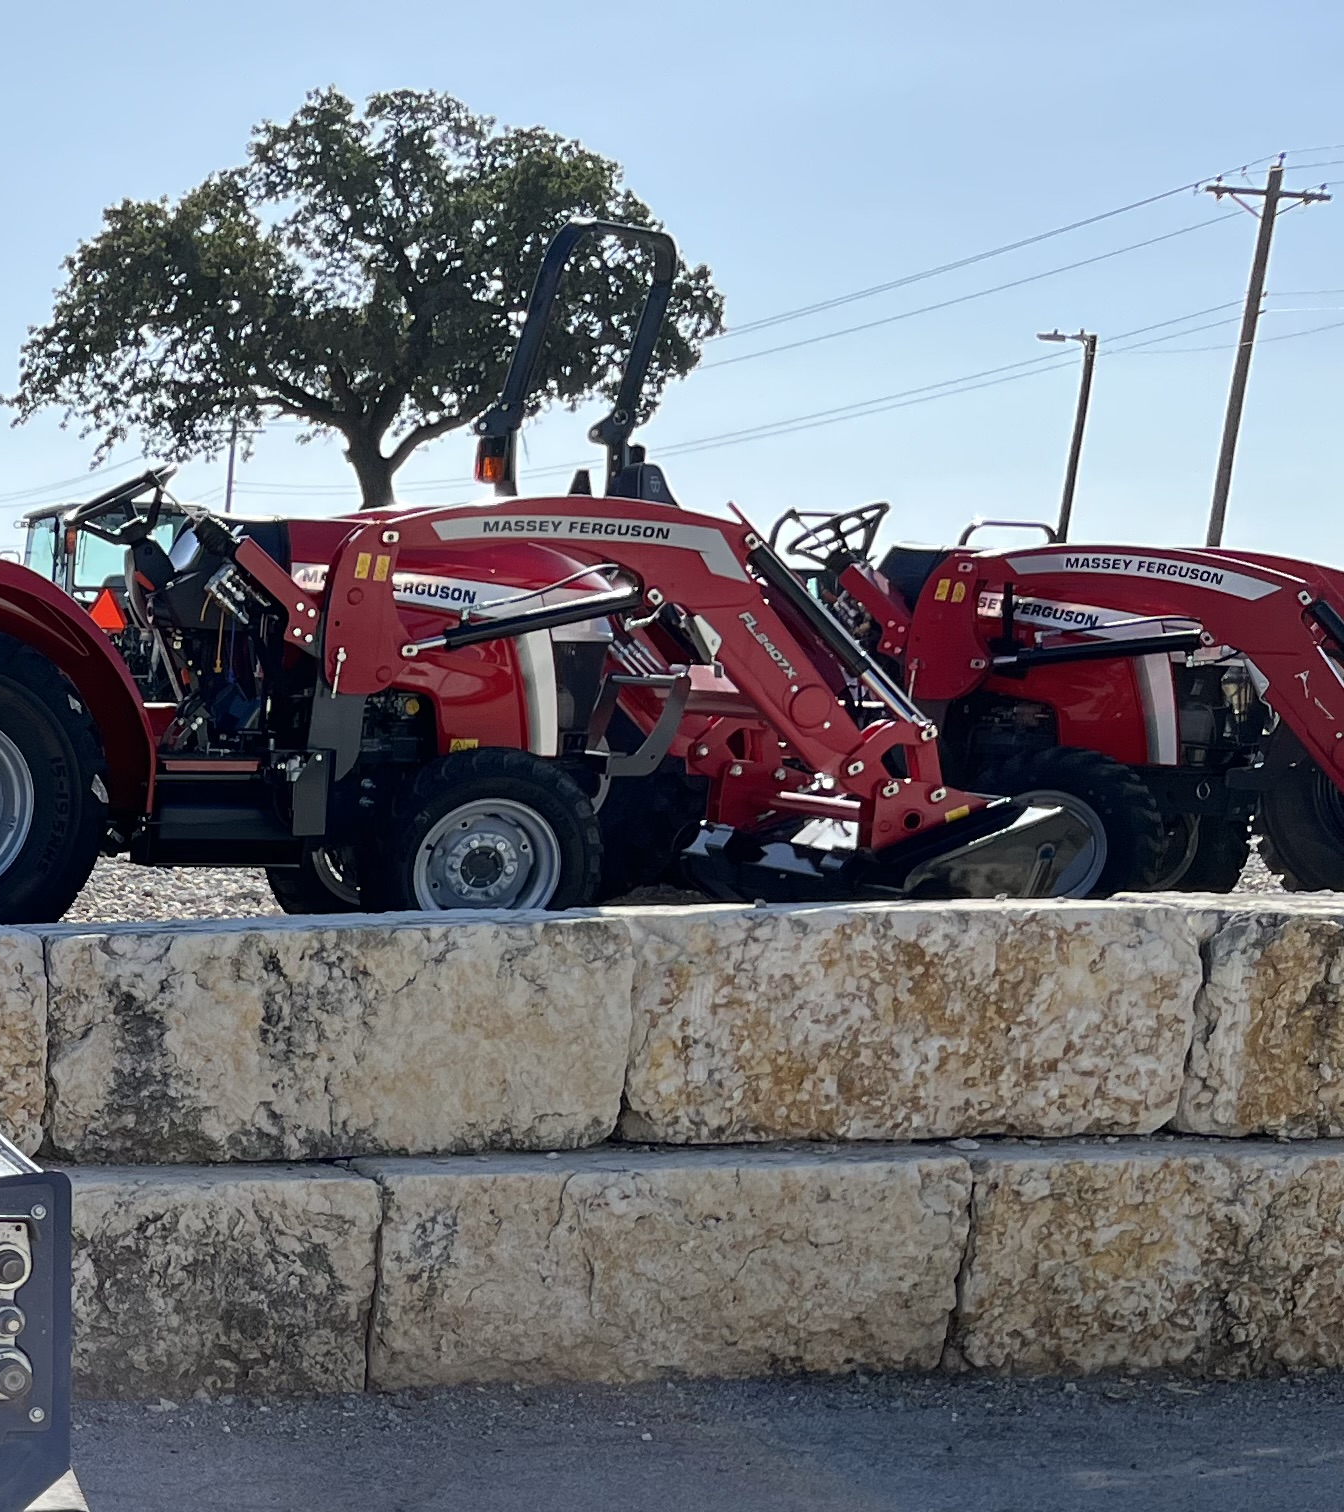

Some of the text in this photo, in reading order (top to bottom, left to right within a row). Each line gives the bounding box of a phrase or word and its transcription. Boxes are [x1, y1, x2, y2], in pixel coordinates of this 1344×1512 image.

[482, 520, 671, 540] MASSEY FERGUSON
[1065, 556, 1224, 586] MASSEY FERGUSON
[394, 583, 477, 605] ERGUSON
[1012, 602, 1099, 628] FERGUSON
